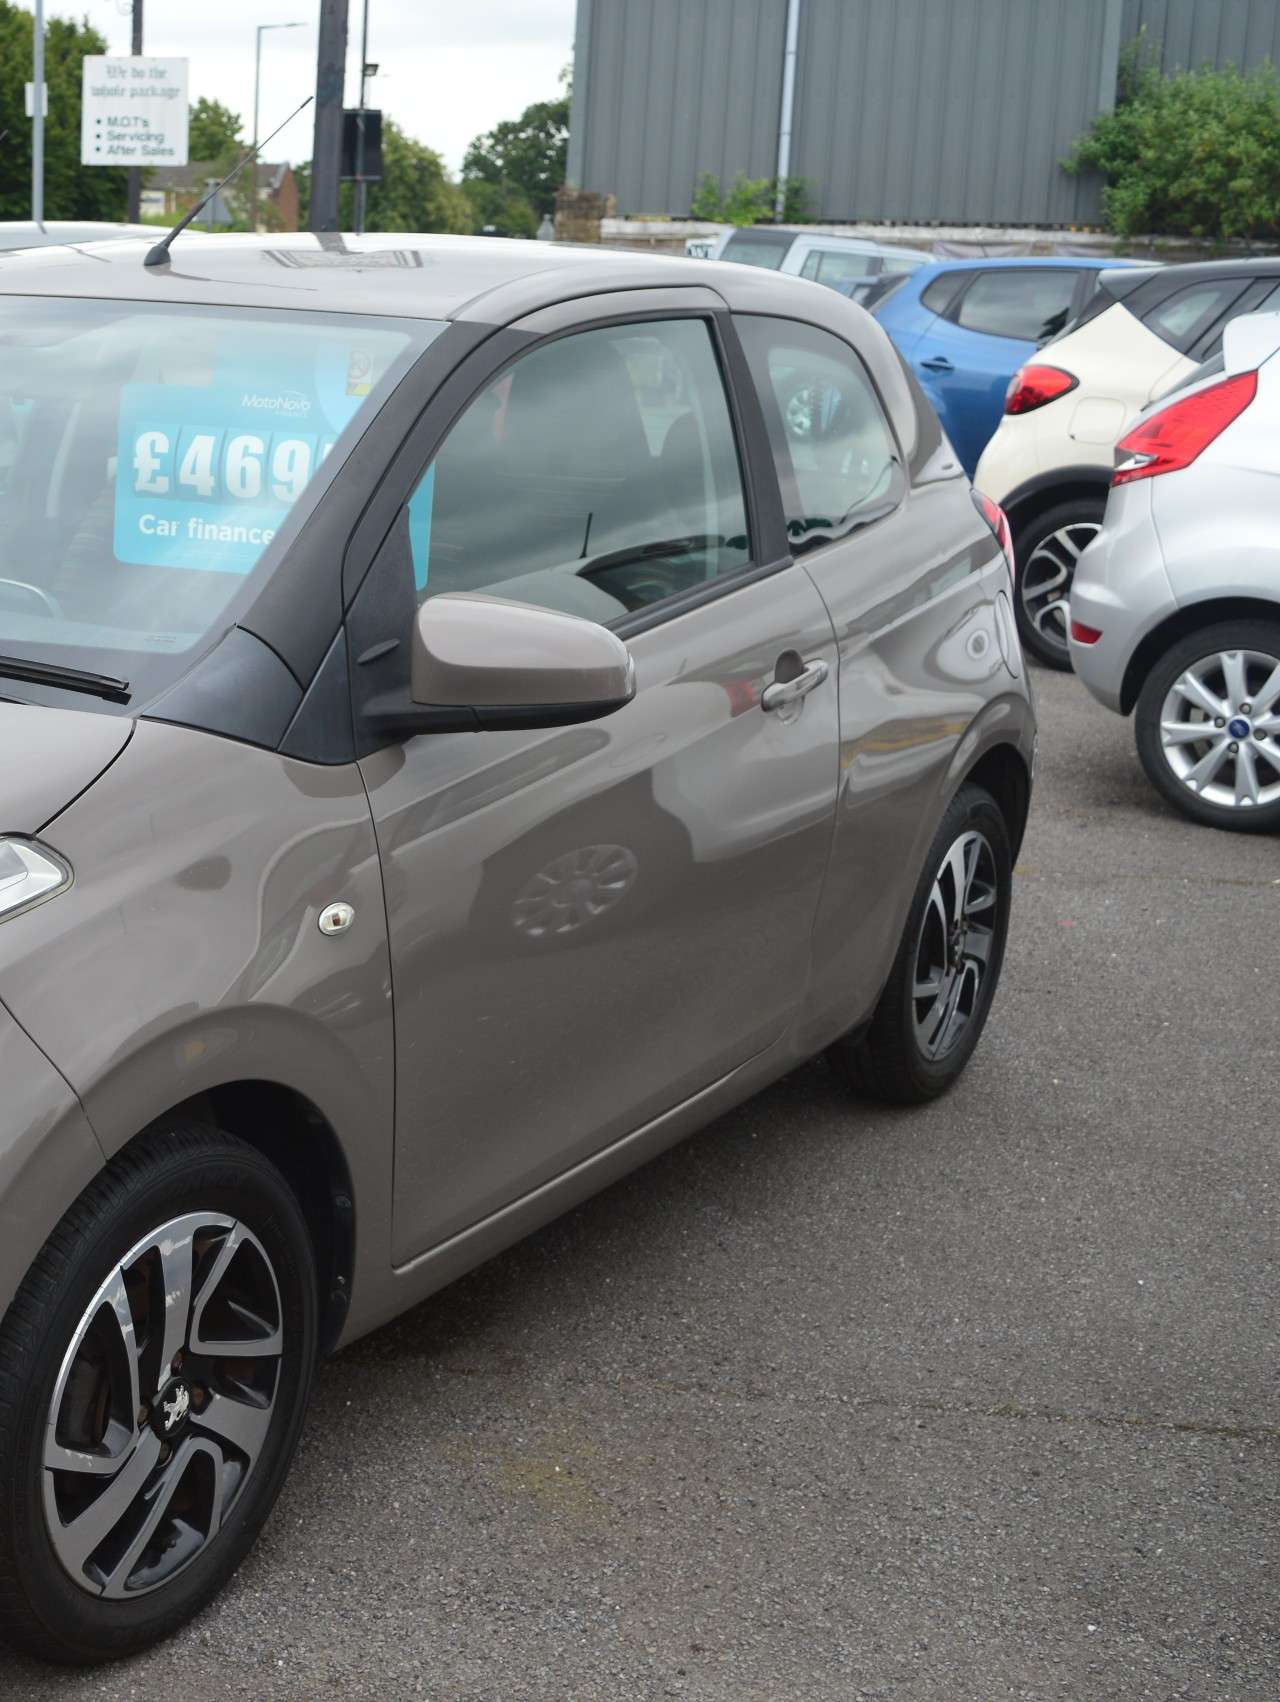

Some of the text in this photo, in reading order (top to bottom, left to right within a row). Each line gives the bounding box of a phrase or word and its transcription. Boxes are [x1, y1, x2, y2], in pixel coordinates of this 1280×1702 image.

[129, 84, 180, 100] package
[106, 129, 165, 145] Servicing
[106, 144, 176, 156] After Sales
[133, 431, 331, 503] £469
[138, 513, 277, 545] Car finance
